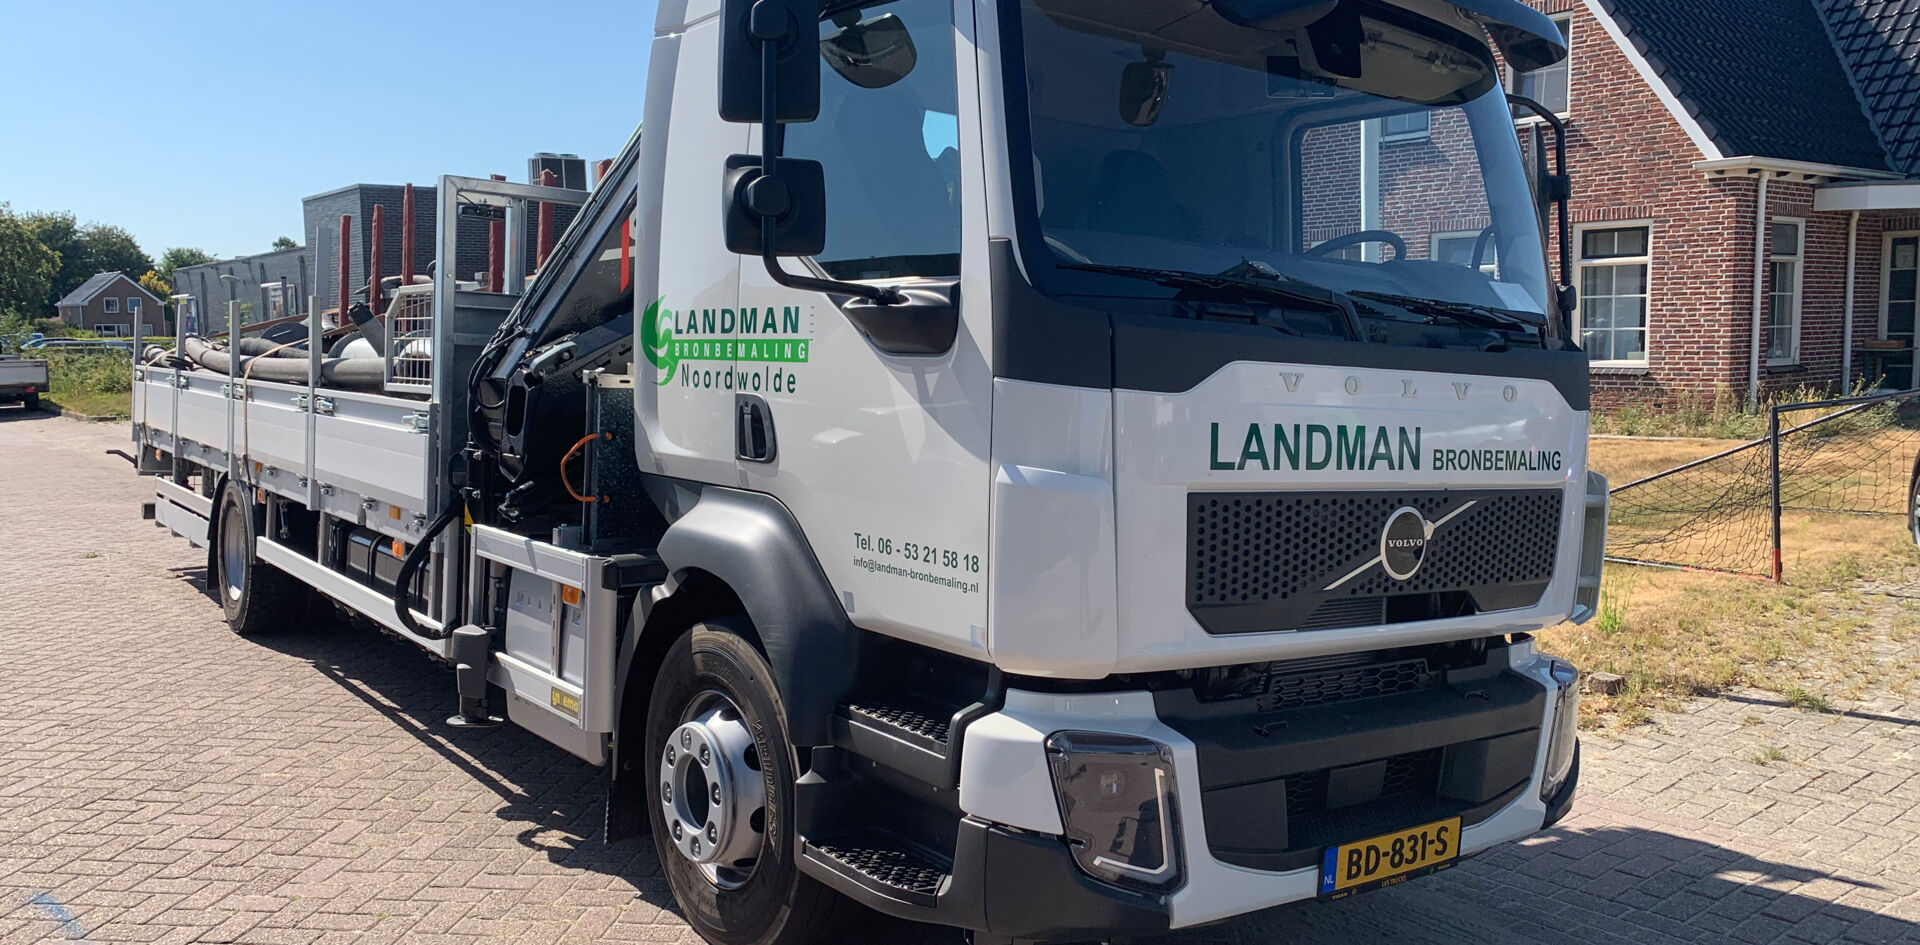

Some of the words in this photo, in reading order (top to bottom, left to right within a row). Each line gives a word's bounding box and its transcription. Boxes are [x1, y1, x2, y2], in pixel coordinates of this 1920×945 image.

[674, 306, 800, 334] LANDMAN
[674, 342, 806, 359] BRONBEMALING
[681, 364, 796, 393] Noordwolde
[1279, 371, 1518, 403] VOLVO
[1209, 422, 1421, 471] LANDMAN
[1432, 448, 1561, 472] BRONBEMALING
[854, 532, 874, 552] Tel.
[878, 537, 892, 555] 06
[904, 542, 919, 561] 53
[923, 545, 937, 565] 21
[942, 549, 958, 569] 58
[963, 553, 979, 573] 18
[1387, 538, 1423, 548] VOLVO
[853, 555, 979, 594] info@landman-bronbemaling.nl
[1346, 826, 1449, 880] BD-831-S
[1323, 875, 1334, 885] NL
